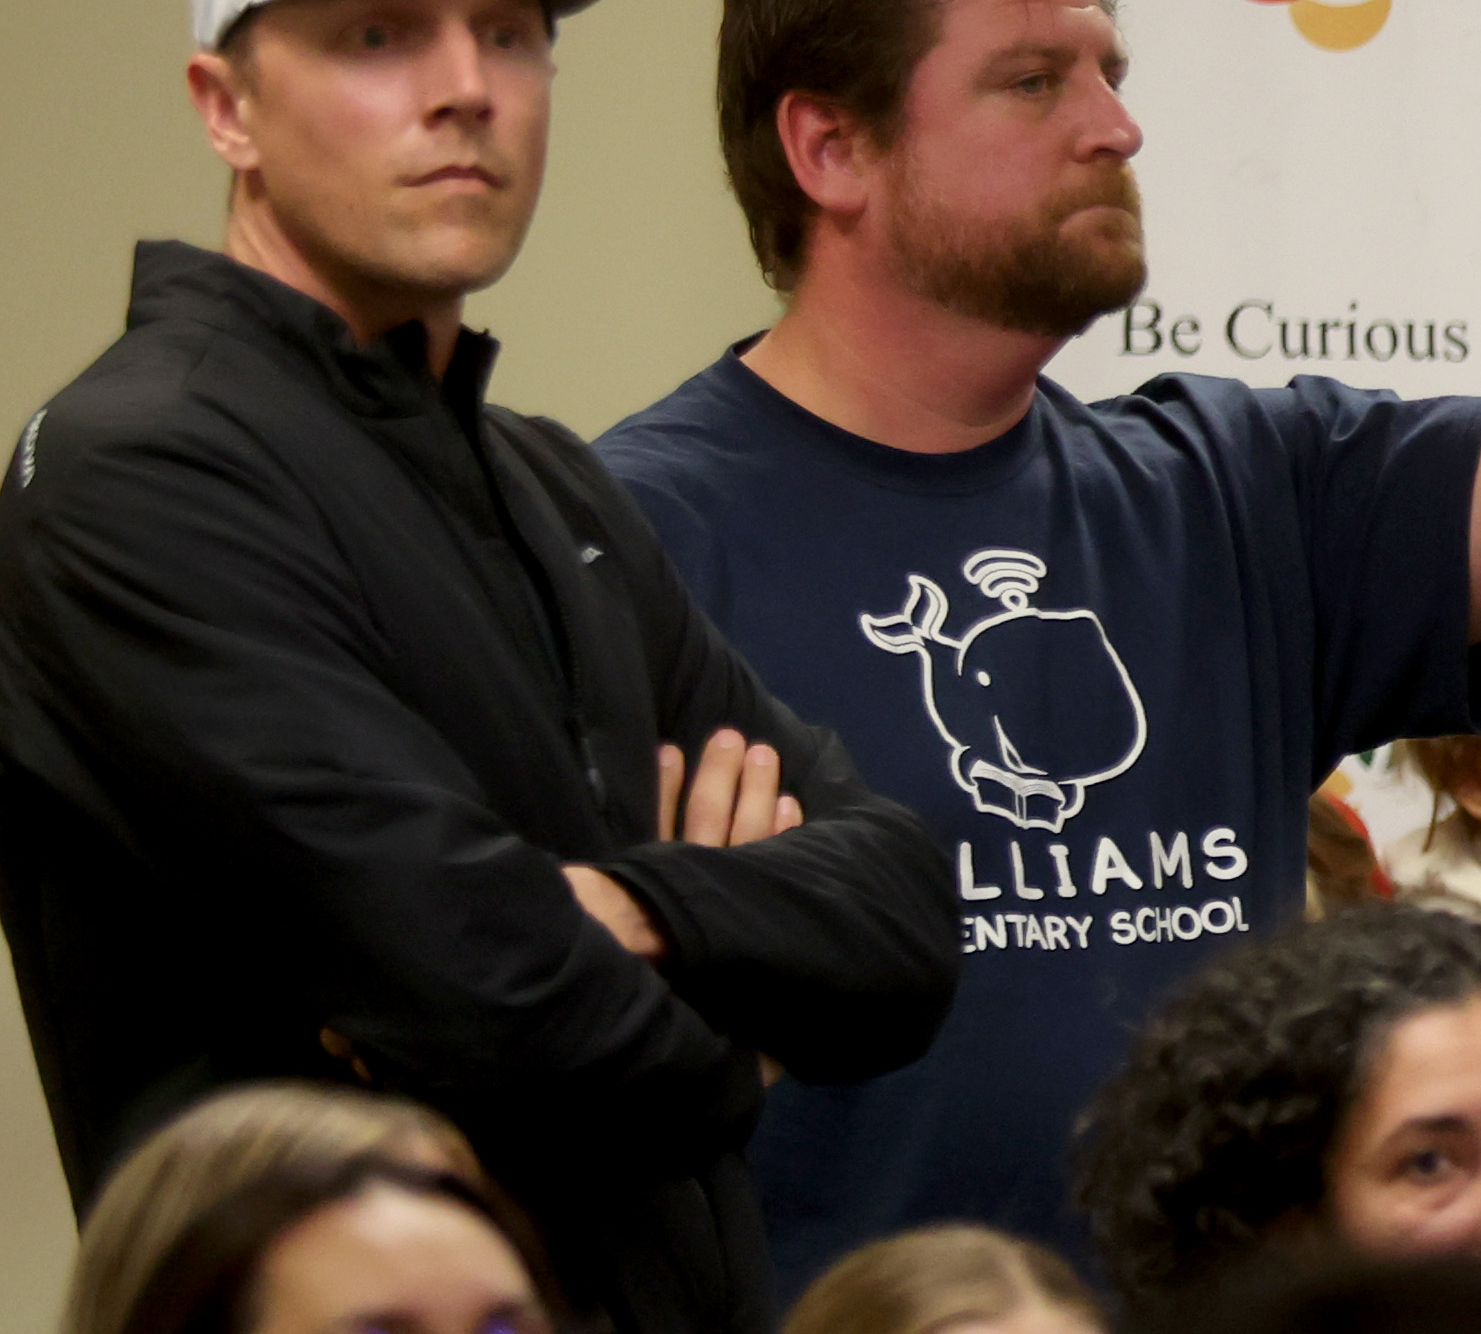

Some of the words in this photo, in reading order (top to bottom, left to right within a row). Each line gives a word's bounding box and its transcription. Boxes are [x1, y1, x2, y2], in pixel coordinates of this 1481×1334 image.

[1118, 299, 1202, 359] Be
[1222, 300, 1471, 364] Curious
[957, 826, 1250, 902] LLIAMS
[961, 912, 1094, 954] ENTARY
[1109, 895, 1250, 946] SCHOOL
